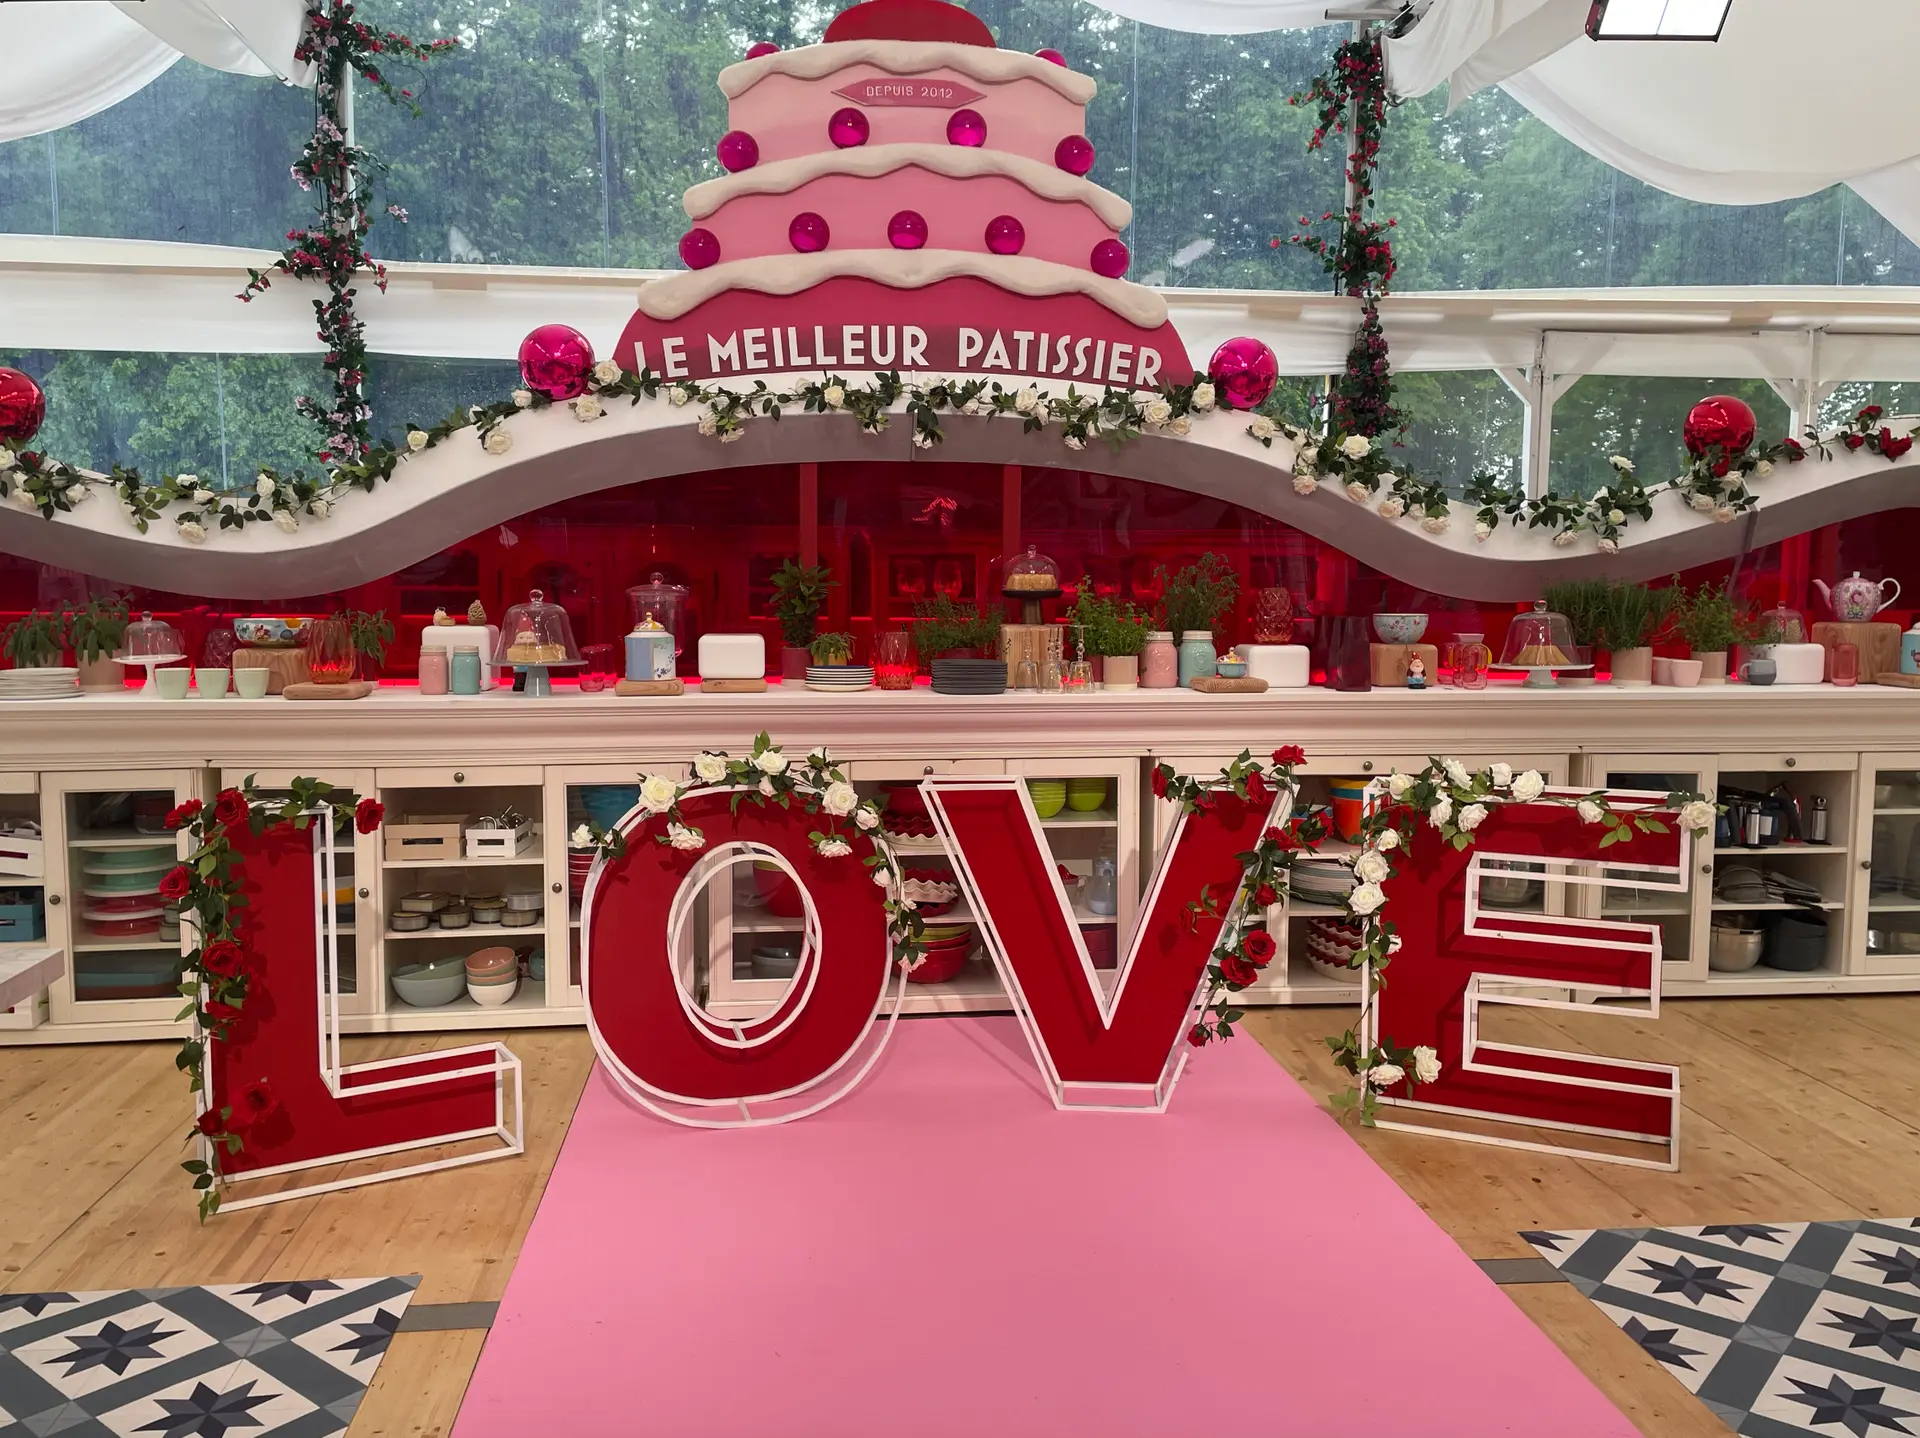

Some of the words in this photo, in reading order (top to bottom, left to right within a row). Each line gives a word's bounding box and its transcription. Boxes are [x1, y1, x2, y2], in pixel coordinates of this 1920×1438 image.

[866, 85, 914, 97] DEPUIS
[921, 86, 953, 99] 2012
[633, 336, 689, 381] LE
[707, 325, 930, 373] MEILLEUR
[958, 327, 1162, 387] PATISSIER
[196, 774, 1691, 1214] LOVE
